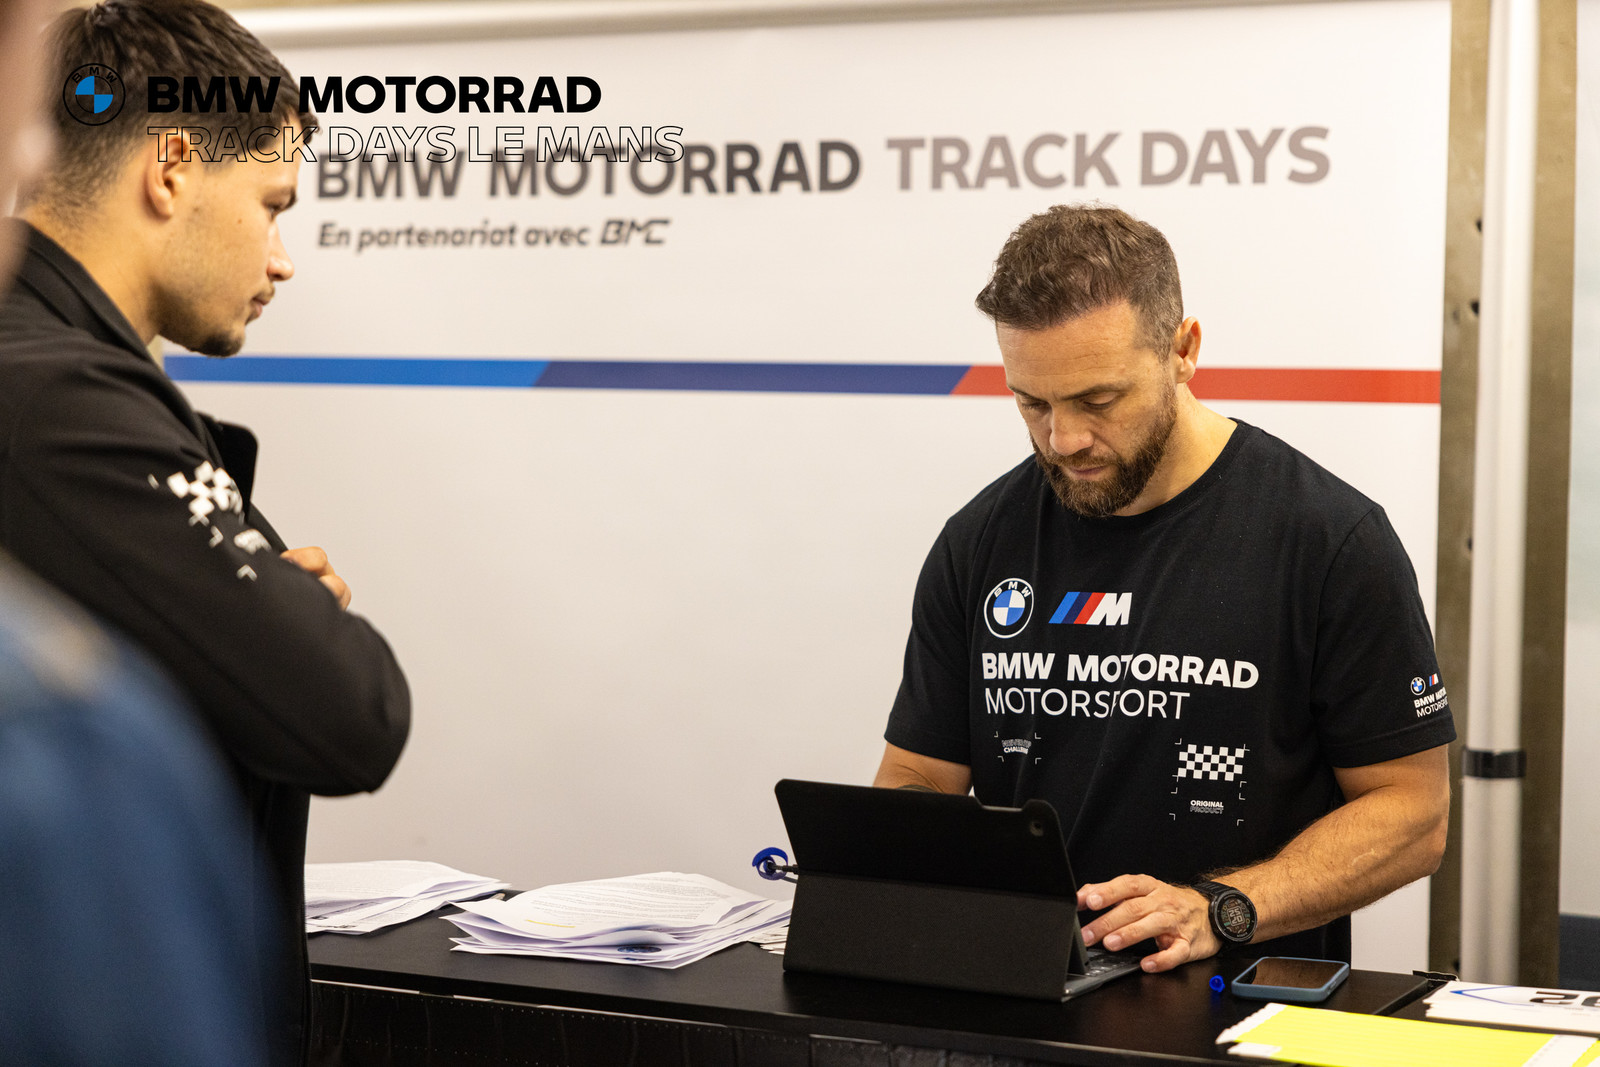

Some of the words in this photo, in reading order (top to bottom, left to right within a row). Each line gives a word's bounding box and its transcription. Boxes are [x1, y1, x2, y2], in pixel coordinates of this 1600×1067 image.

[318, 152, 465, 198] BMW
[490, 140, 861, 197] MOTORRAD
[886, 132, 1121, 190] TRACK
[1139, 126, 1332, 186] DAYS
[319, 222, 351, 247] En
[357, 220, 517, 255] partenariat
[524, 227, 591, 247] avec
[981, 652, 1056, 680] BMW
[1066, 653, 1260, 689] MOTORRAD
[984, 687, 1191, 720] MOTORSPORT
[1413, 693, 1435, 708] BMW
[1190, 800, 1224, 808] ORIGINAL
